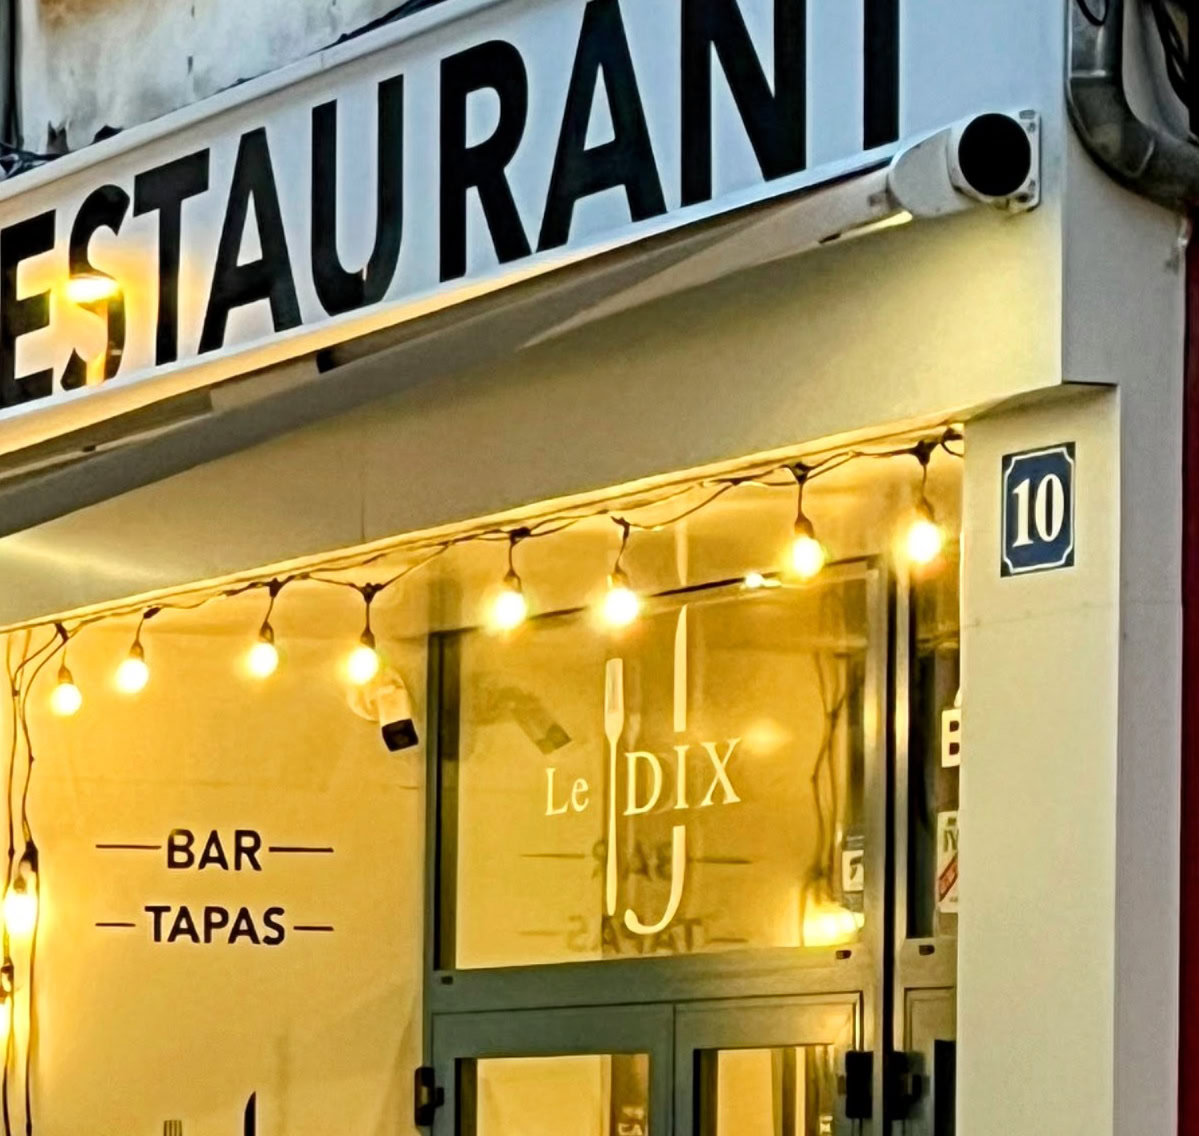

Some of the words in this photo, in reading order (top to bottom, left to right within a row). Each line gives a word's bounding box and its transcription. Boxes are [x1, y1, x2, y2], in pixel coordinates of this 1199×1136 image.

[1012, 473, 1066, 548] 10
[545, 766, 590, 816] Le
[622, 738, 741, 817] DIX
[167, 828, 263, 871] BAR
[144, 905, 286, 946] TAPAS
